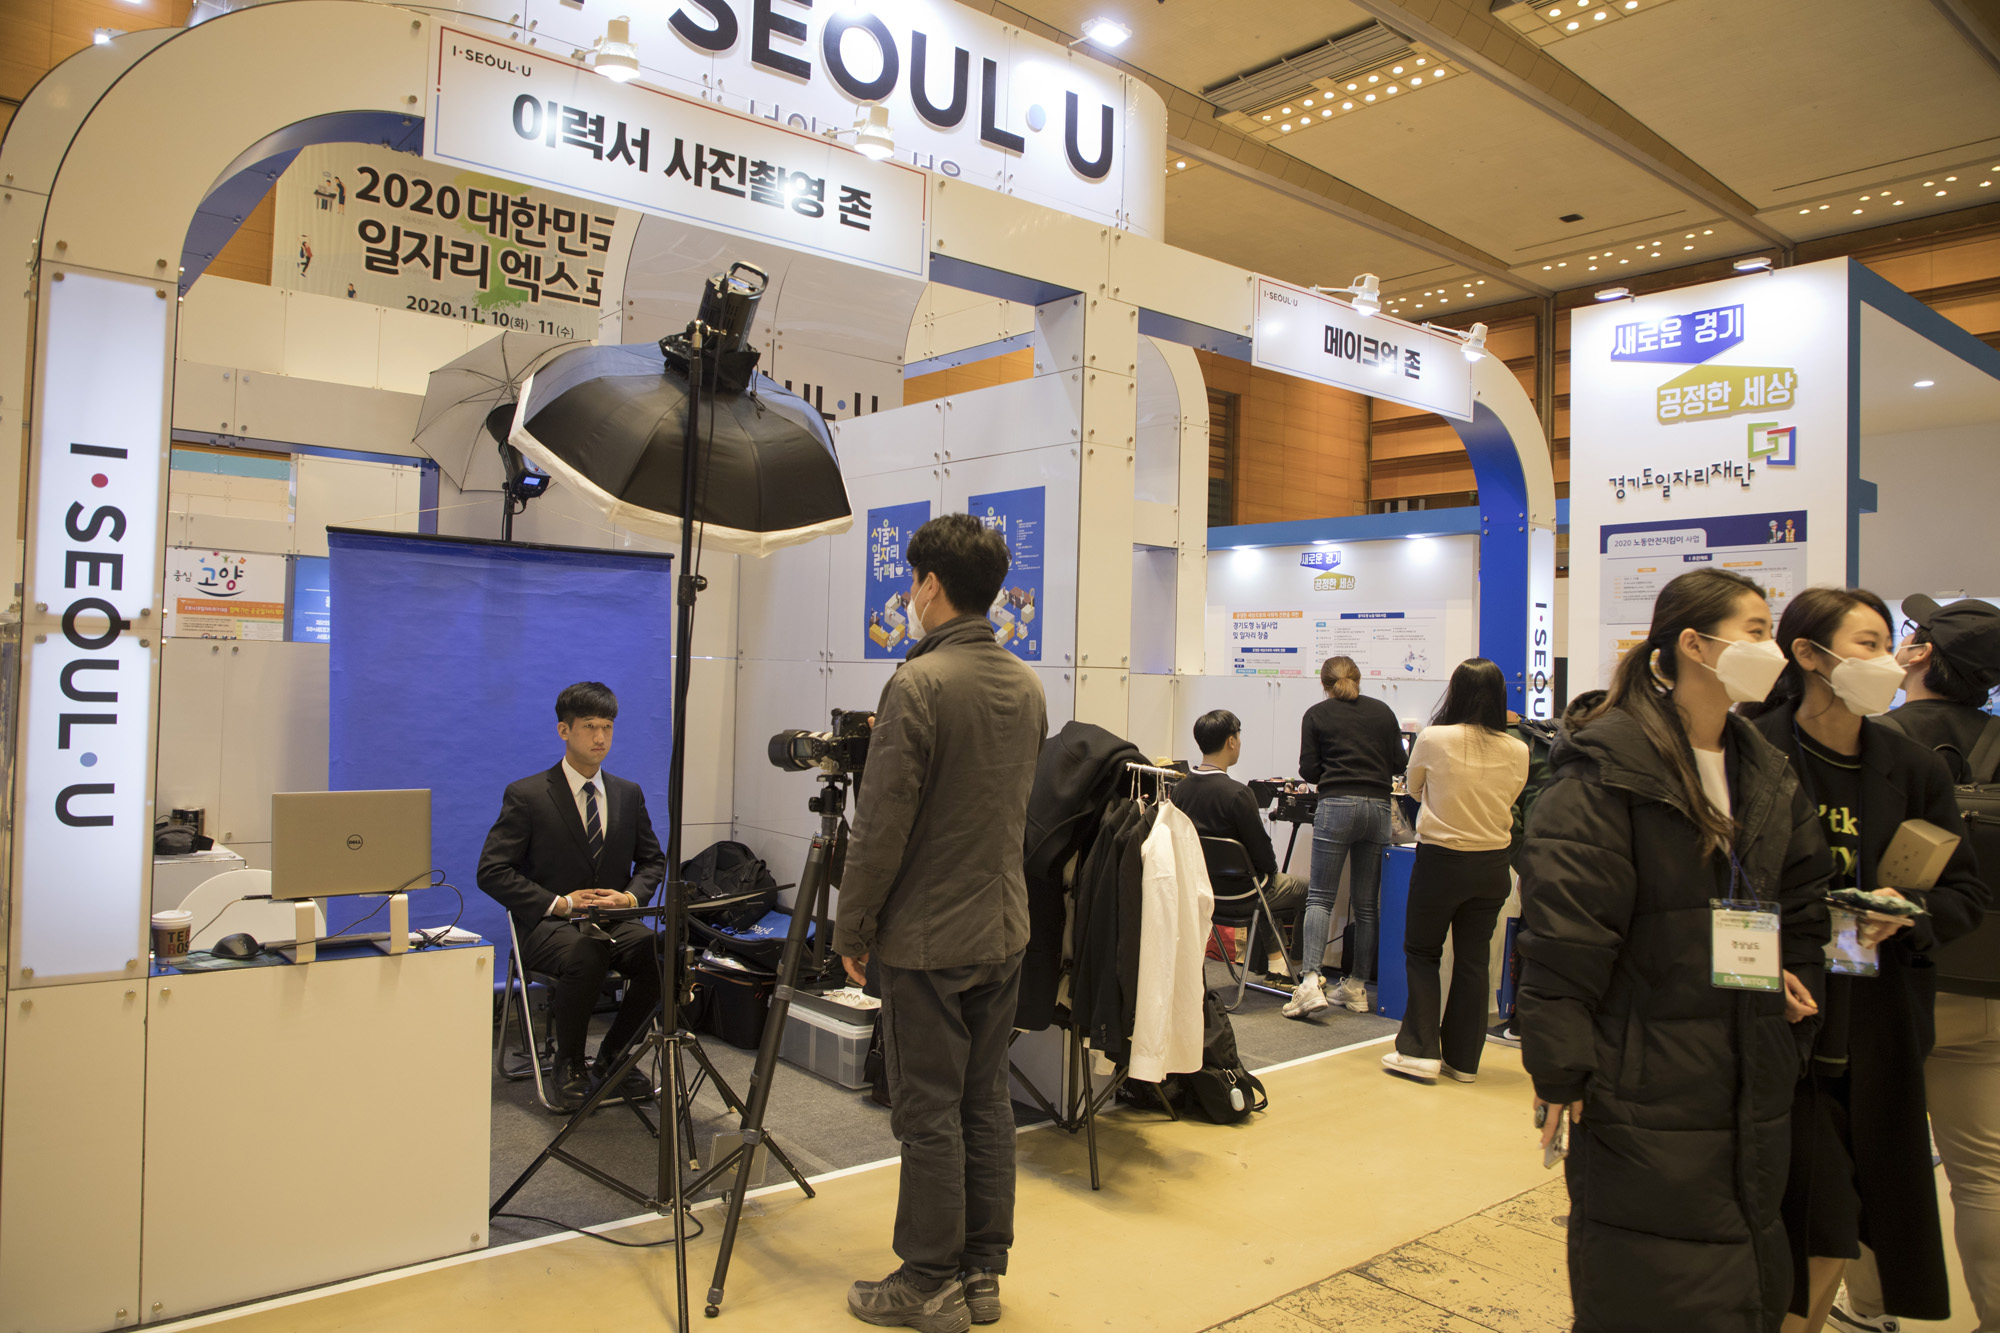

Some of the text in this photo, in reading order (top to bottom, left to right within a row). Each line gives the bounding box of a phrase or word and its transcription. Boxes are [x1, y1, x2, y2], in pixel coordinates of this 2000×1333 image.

[512, 93, 873, 232] 이력서 사진촬영 존
[355, 166, 461, 220] 2020
[357, 219, 490, 290] 일자리
[1613, 307, 1742, 355] 새로운 경기
[1323, 324, 1421, 380] 메이크업 존
[1659, 371, 1794, 419] 공정한 세상
[1608, 460, 1755, 500] 경기도일자리재단
[870, 518, 899, 546] 서울시
[1614, 535, 1700, 548] 2020 노동안전지킴이 사업
[871, 543, 900, 567] 일자리
[1301, 551, 1341, 565] 새로운 경기
[173, 565, 244, 591] 중심 고양
[873, 563, 895, 583] 카페
[1314, 577, 1355, 590] 공정한 세상
